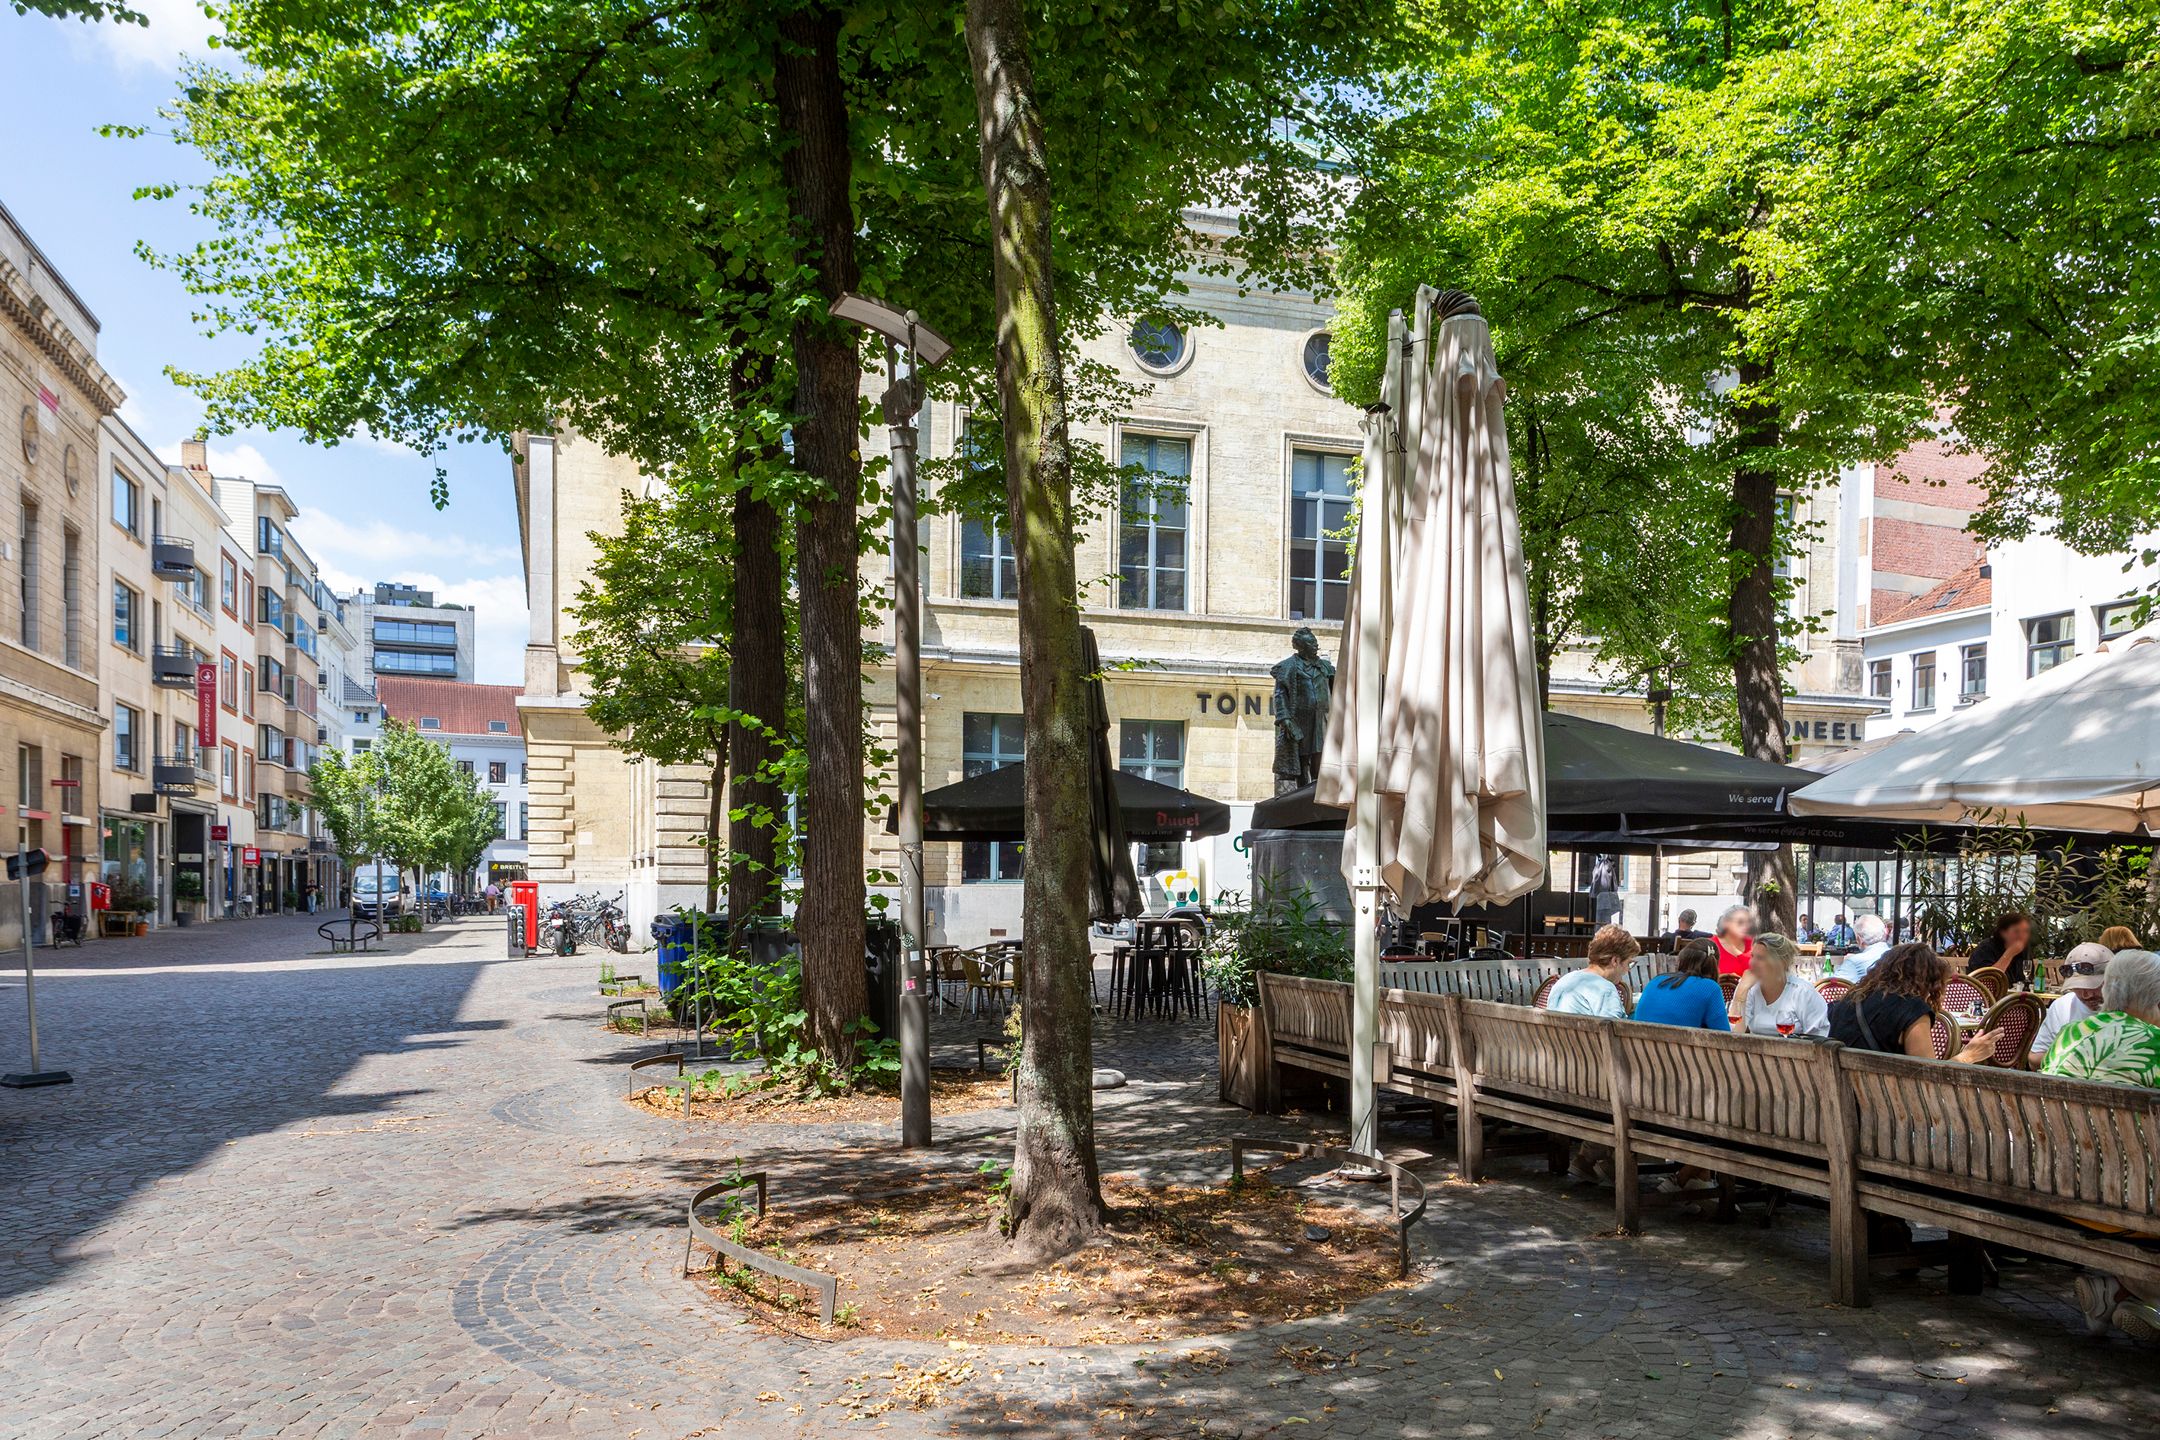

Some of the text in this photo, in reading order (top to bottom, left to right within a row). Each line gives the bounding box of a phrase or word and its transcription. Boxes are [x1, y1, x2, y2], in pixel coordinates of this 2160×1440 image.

[1729, 794, 1744, 803] We
[1156, 811, 1199, 827] Duvel
[1823, 830, 1845, 838] COLD
